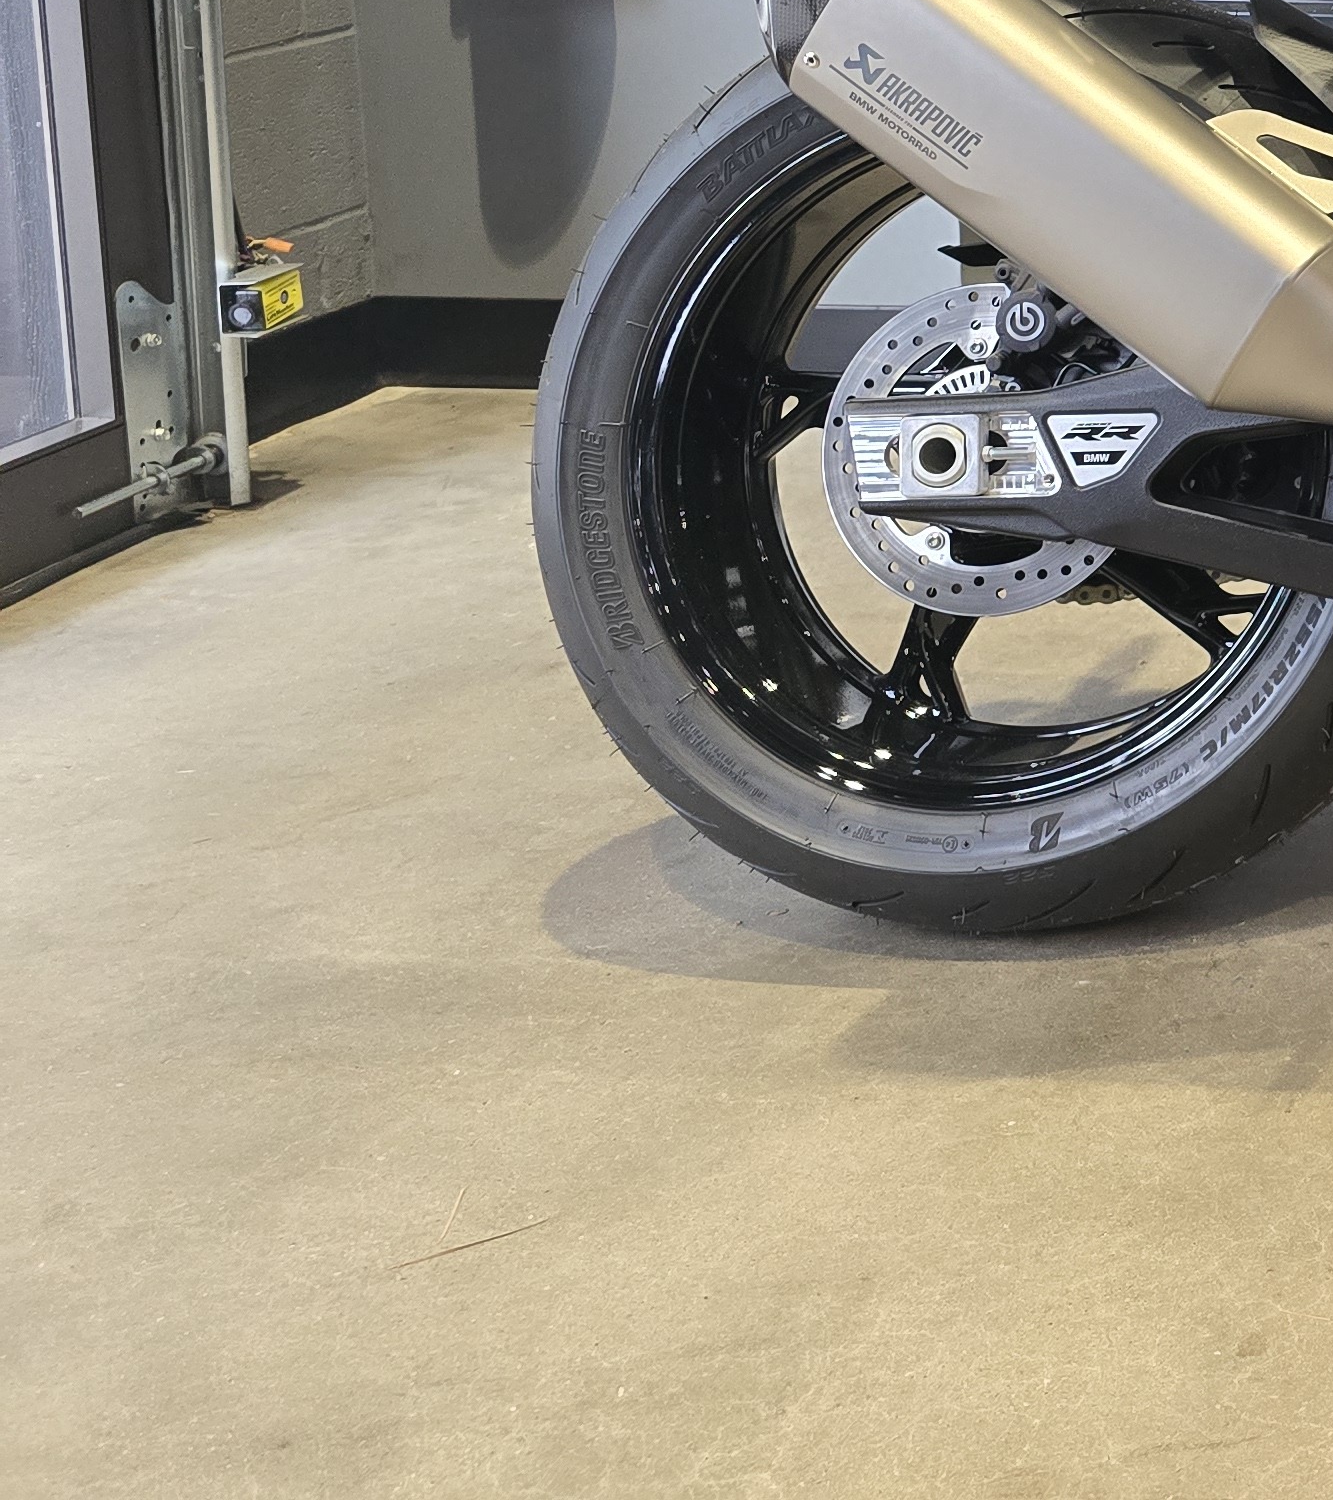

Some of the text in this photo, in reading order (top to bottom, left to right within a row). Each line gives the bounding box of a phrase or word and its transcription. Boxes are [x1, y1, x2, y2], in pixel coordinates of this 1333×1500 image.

[848, 91, 938, 161] BMW MOTORRAD
[1083, 453, 1111, 463] BMW
[576, 428, 645, 651] BRIDGESTONE
